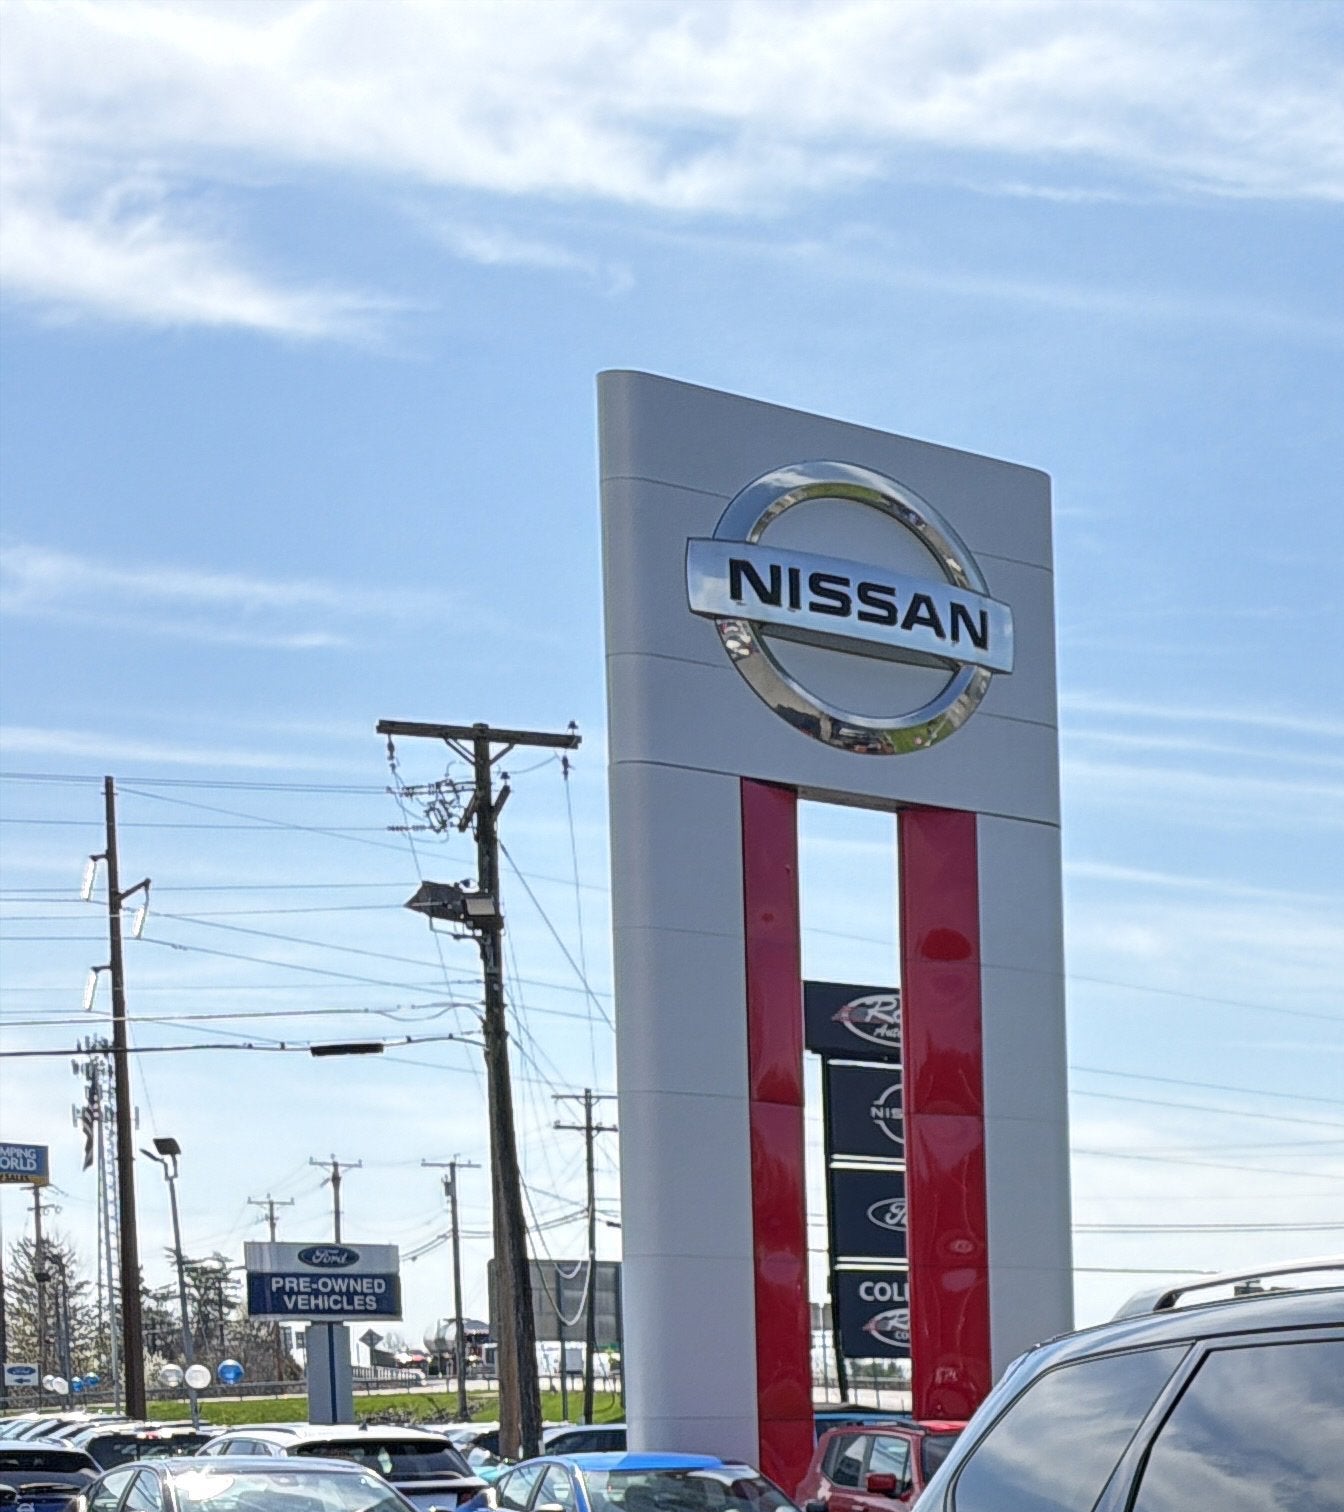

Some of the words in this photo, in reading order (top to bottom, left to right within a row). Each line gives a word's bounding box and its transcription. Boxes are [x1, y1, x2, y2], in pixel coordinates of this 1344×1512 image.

[728, 557, 990, 651] NISSAN
[311, 1248, 348, 1264] Ford
[271, 1277, 387, 1294] PRE-OWNED
[283, 1294, 378, 1311] VEHICLES
